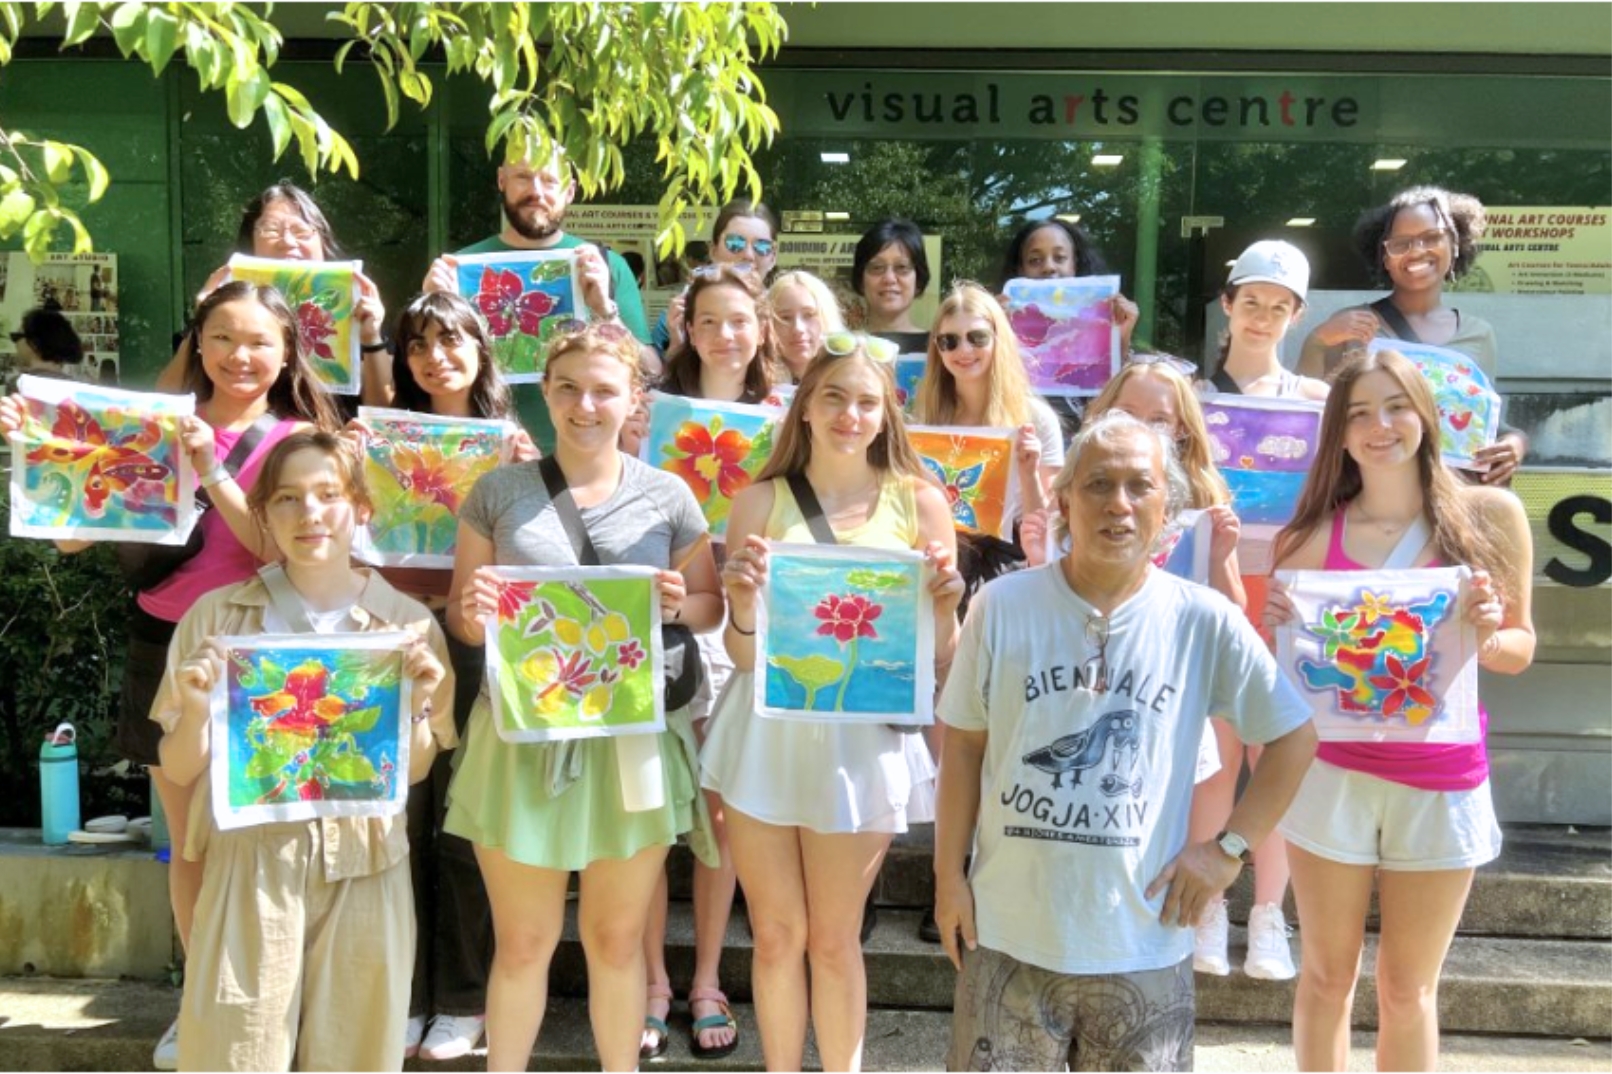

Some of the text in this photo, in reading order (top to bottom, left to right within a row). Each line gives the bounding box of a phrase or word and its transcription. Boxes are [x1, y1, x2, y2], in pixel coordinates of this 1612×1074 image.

[827, 83, 1360, 127] visual arts centre
[581, 210, 600, 219] ART
[601, 210, 644, 219] COURSES
[1485, 214, 1607, 226] NAL ART COURSES
[1491, 227, 1576, 239] WORKSHOPS
[779, 242, 828, 253] BONDING
[1527, 244, 1560, 252] CENTRE
[1542, 494, 1612, 587] S
[1024, 665, 1176, 714] BIENNALE
